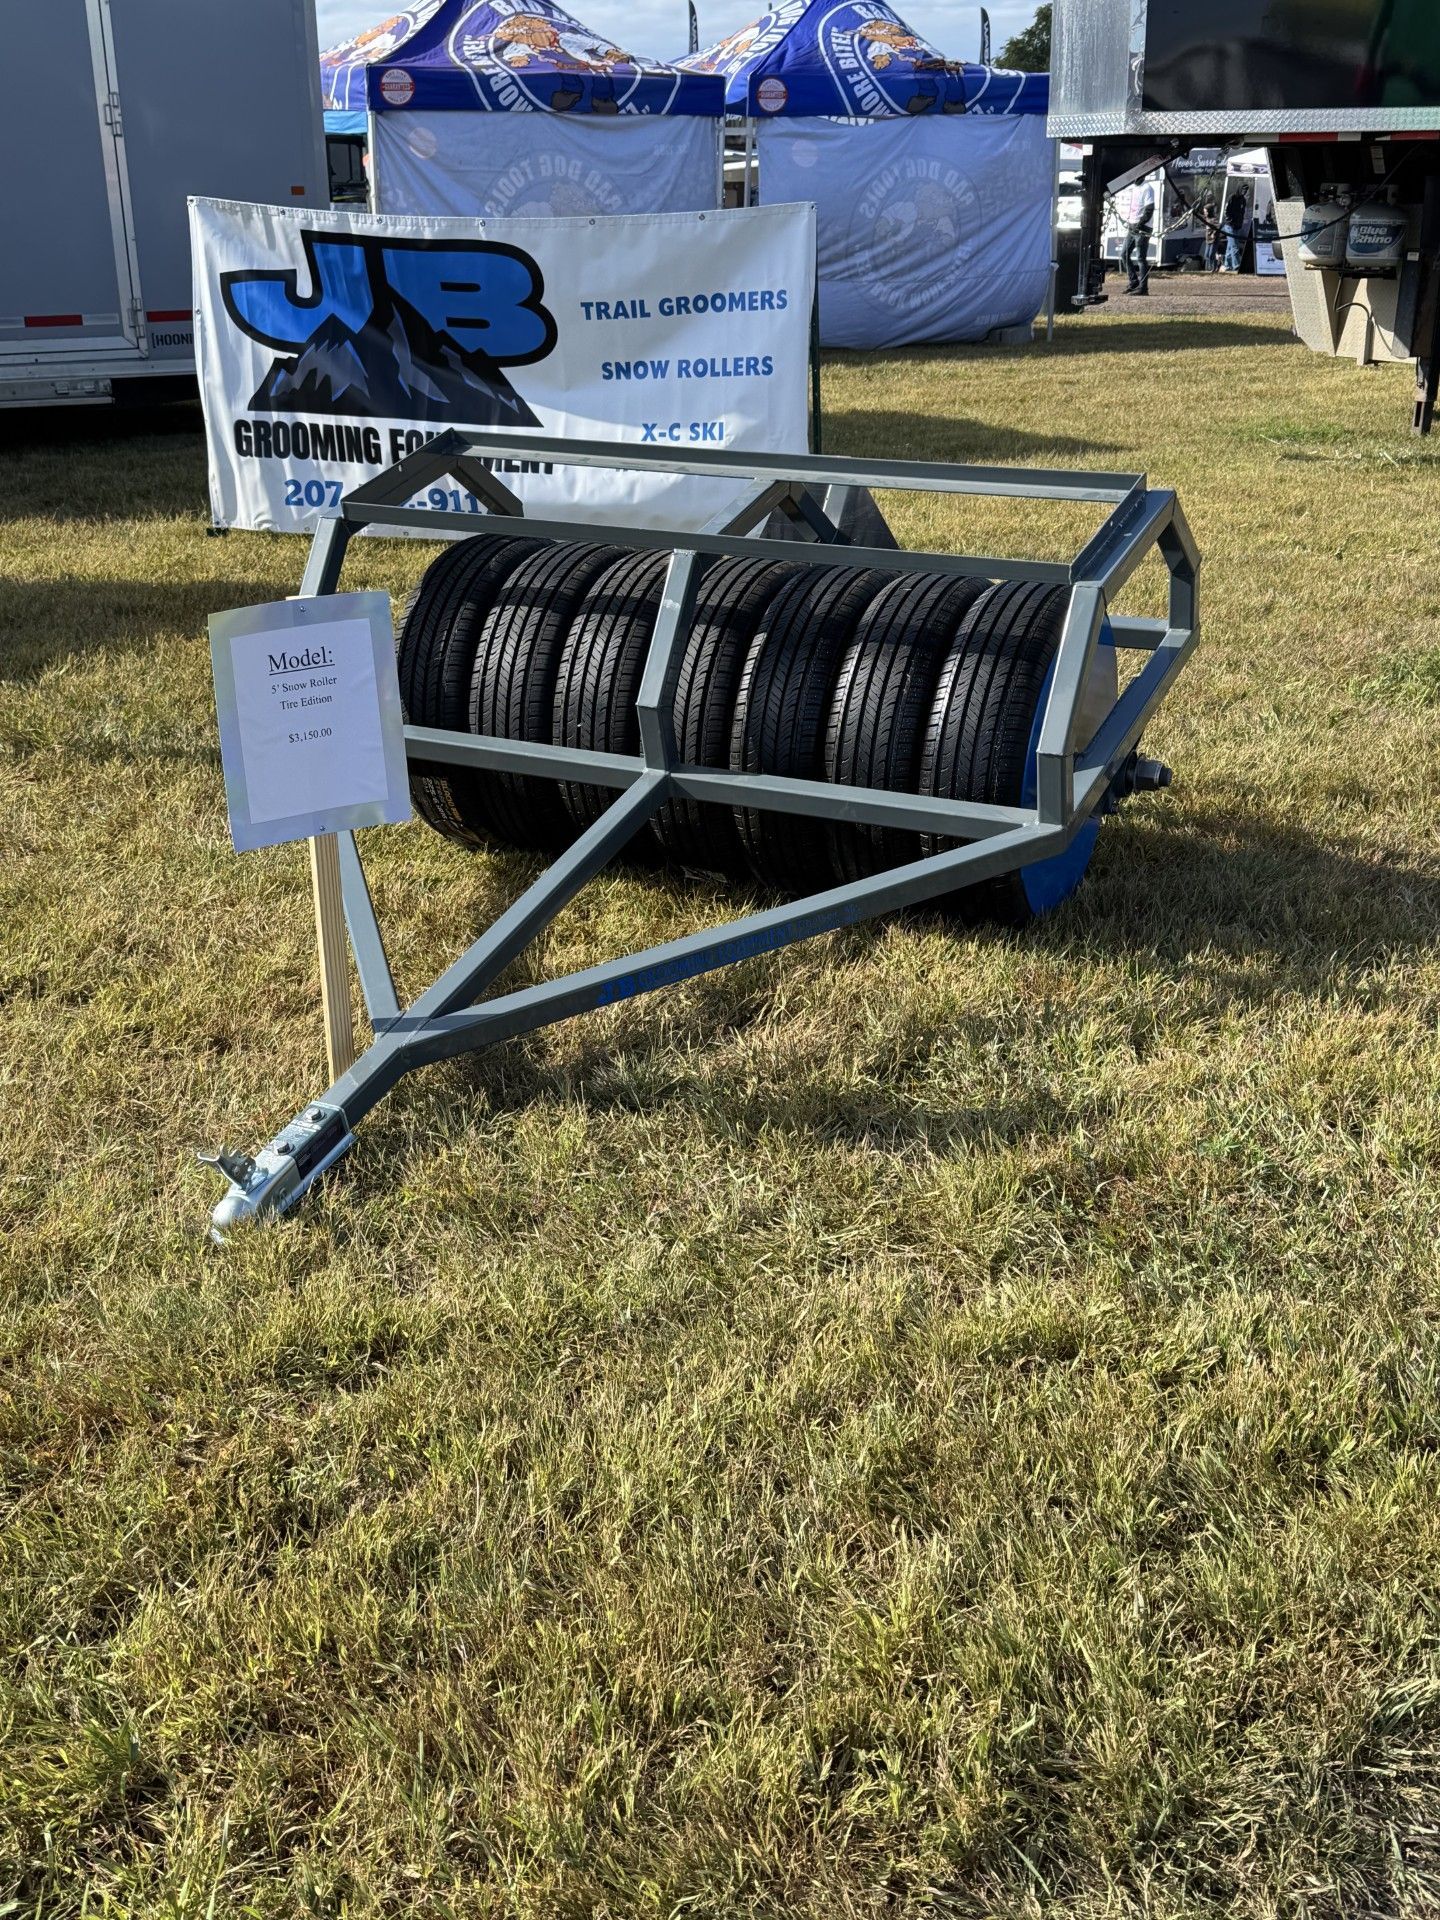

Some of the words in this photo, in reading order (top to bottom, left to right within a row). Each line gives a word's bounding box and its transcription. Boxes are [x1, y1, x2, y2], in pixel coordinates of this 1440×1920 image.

[1360, 226, 1387, 235] Blue
[220, 229, 558, 368] JB
[580, 299, 651, 321] TRAIL
[658, 289, 788, 317] GROOMERS
[601, 360, 670, 380] SNOW
[677, 355, 774, 378] ROLLERS
[233, 419, 383, 465] GROOMING
[641, 423, 681, 442] X-C
[689, 421, 724, 442] SKI
[268, 646, 333, 673] Model:
[271, 684, 280, 695] 5'
[282, 682, 308, 693] Snow
[310, 676, 337, 689] Roller
[280, 699, 299, 710] Tire
[301, 695, 333, 707] Edition
[287, 727, 333, 743] $3,150.00
